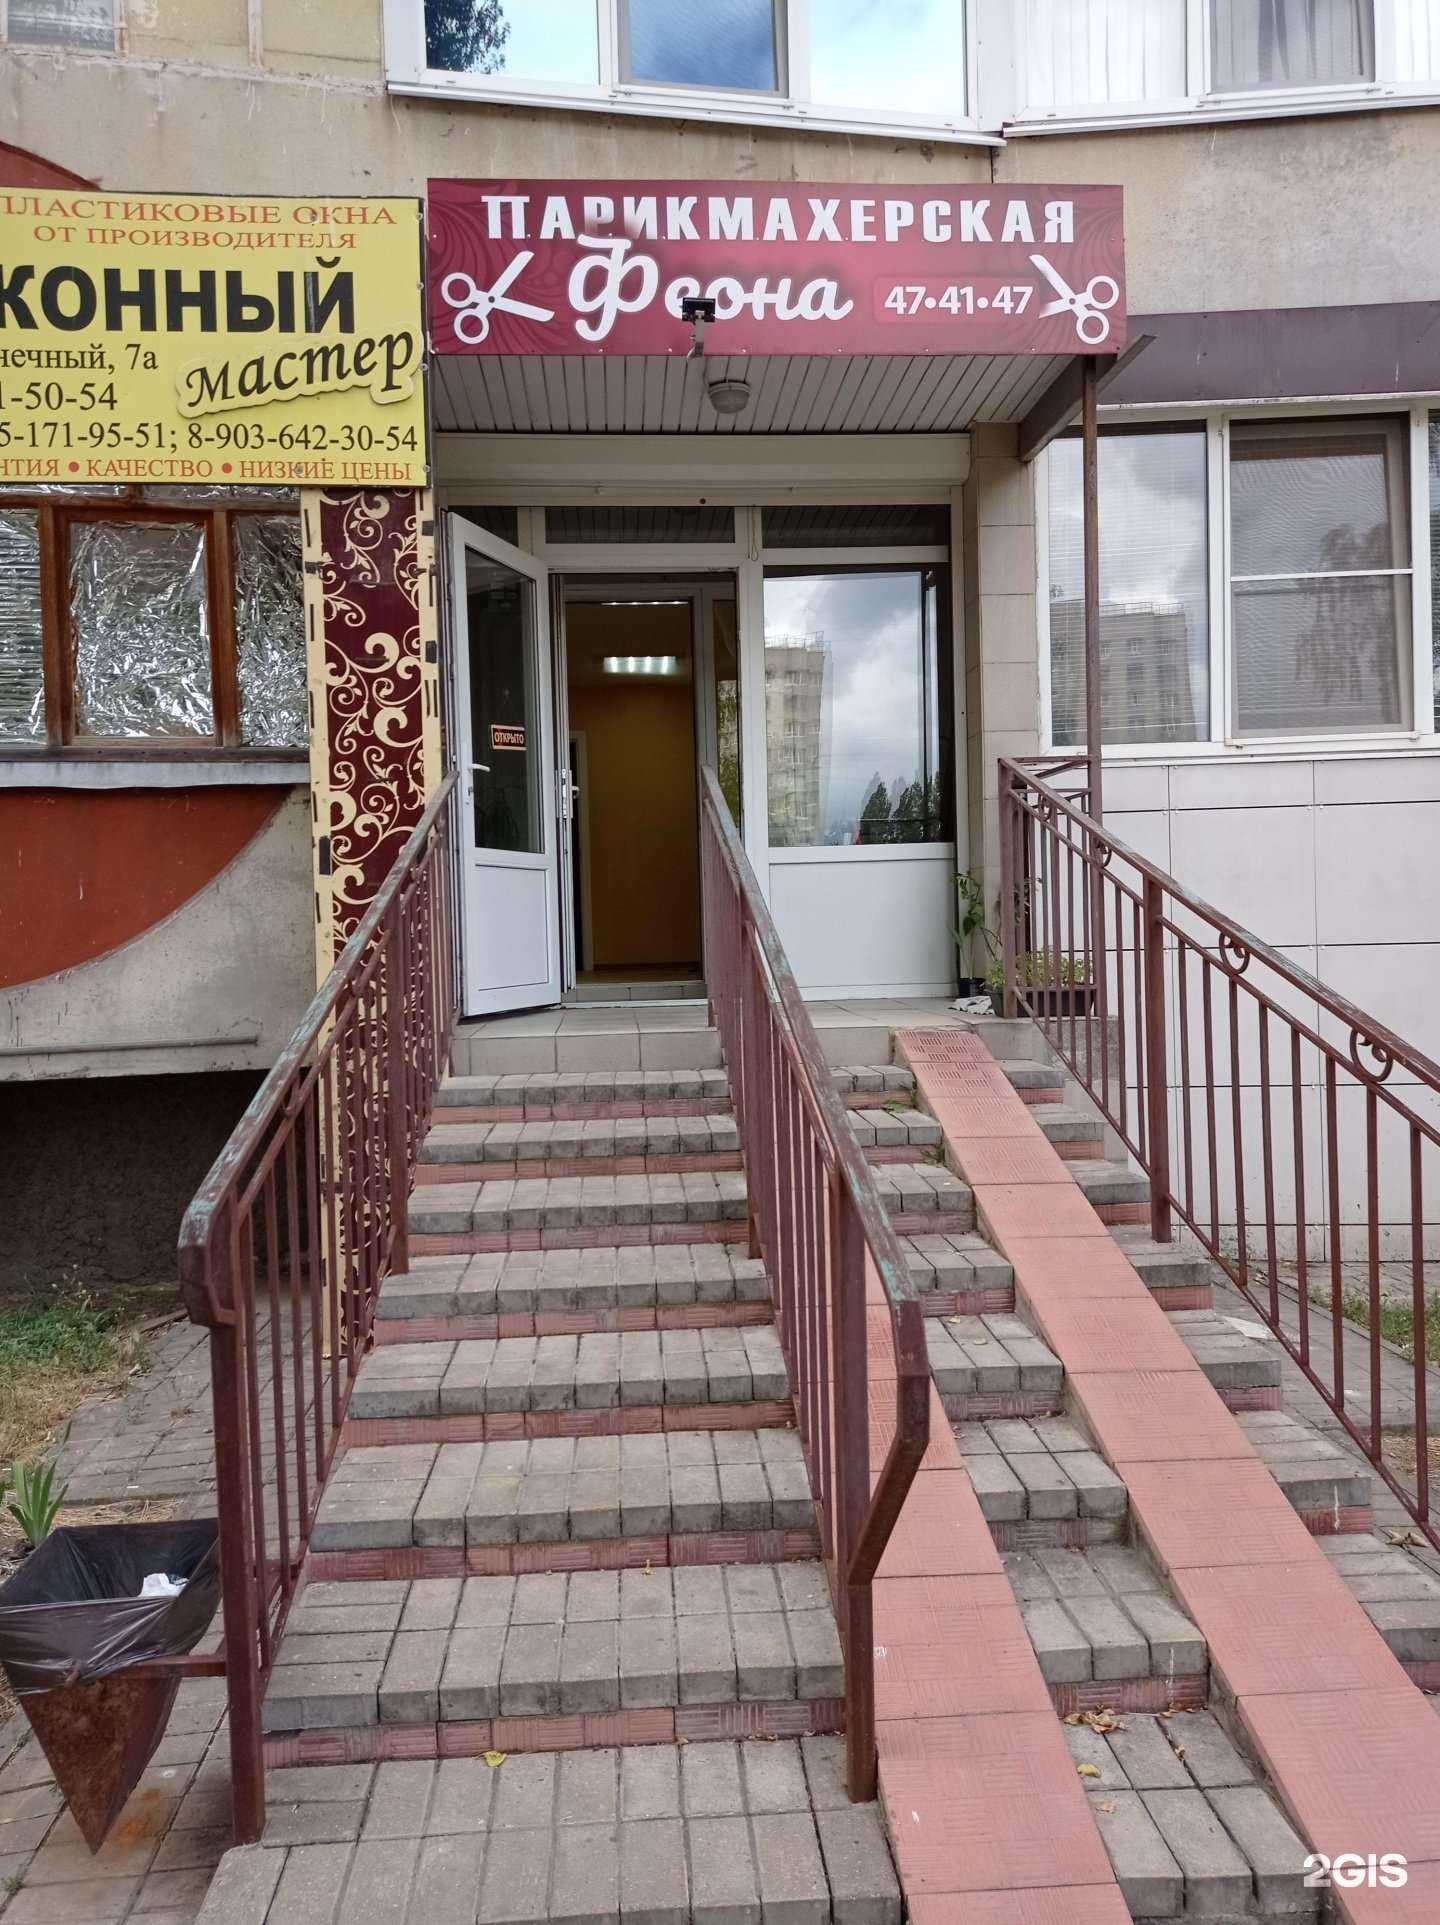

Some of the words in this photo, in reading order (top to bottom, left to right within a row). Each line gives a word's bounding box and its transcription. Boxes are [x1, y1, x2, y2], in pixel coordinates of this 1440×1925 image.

[292, 206, 397, 225] ОКНА
[481, 195, 1074, 244] ПАРИКМАХЕРСКАЯ
[34, 225, 77, 243] ОТ
[86, 227, 356, 250] ПРОИЗВОДИТЕЛЯ
[568, 234, 854, 342] Феона
[124, 343, 158, 370] 7а
[187, 423, 418, 451] 8-903-642-30-54
[87, 459, 213, 478] КАЧЕСТВО
[239, 460, 334, 479] НИЗКИЕ
[341, 462, 412, 482] ЦЕНЫ
[494, 732, 524, 744] ОТКРЫТО
